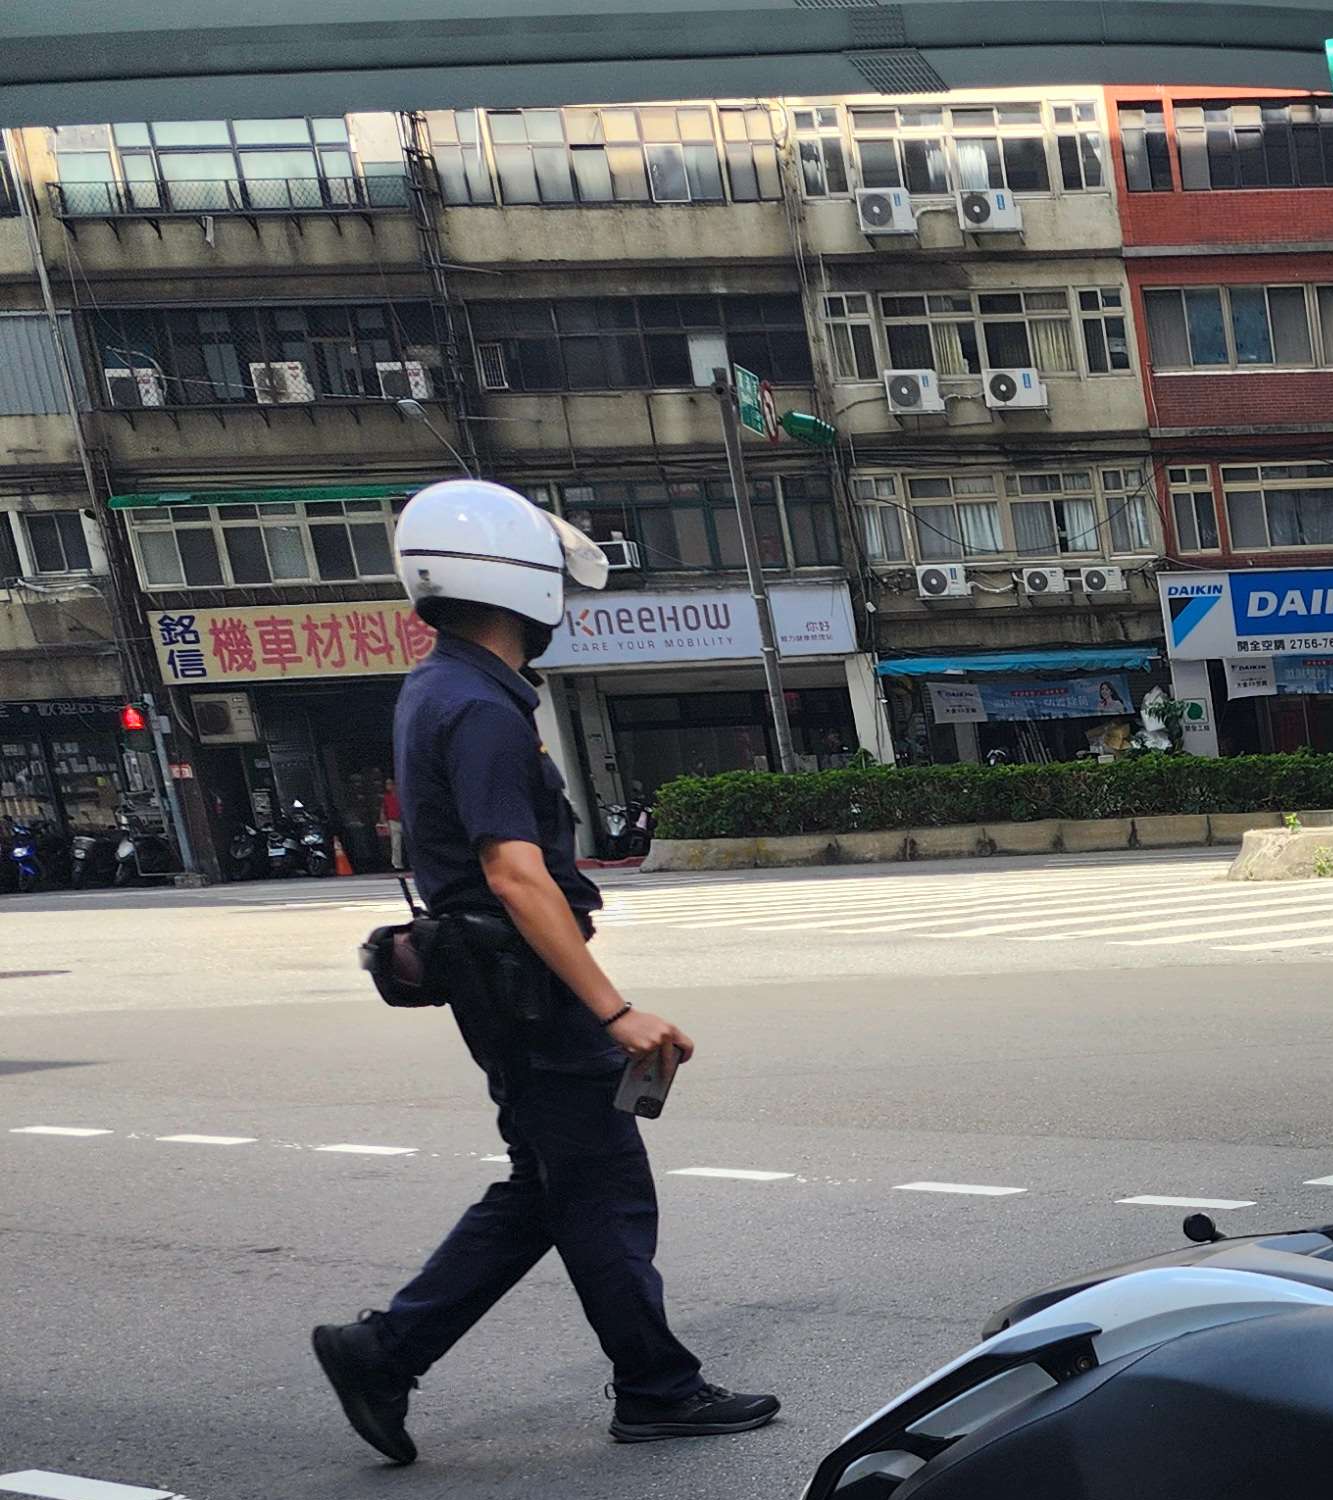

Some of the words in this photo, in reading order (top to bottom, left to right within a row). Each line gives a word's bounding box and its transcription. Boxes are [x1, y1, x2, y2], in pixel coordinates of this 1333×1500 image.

[1167, 584, 1223, 596] DAIKIN
[806, 621, 830, 632] 你好
[158, 614, 207, 679] 銘信
[572, 642, 609, 652] CARE
[617, 640, 655, 650] YOUR
[664, 637, 734, 648] MOBILITY
